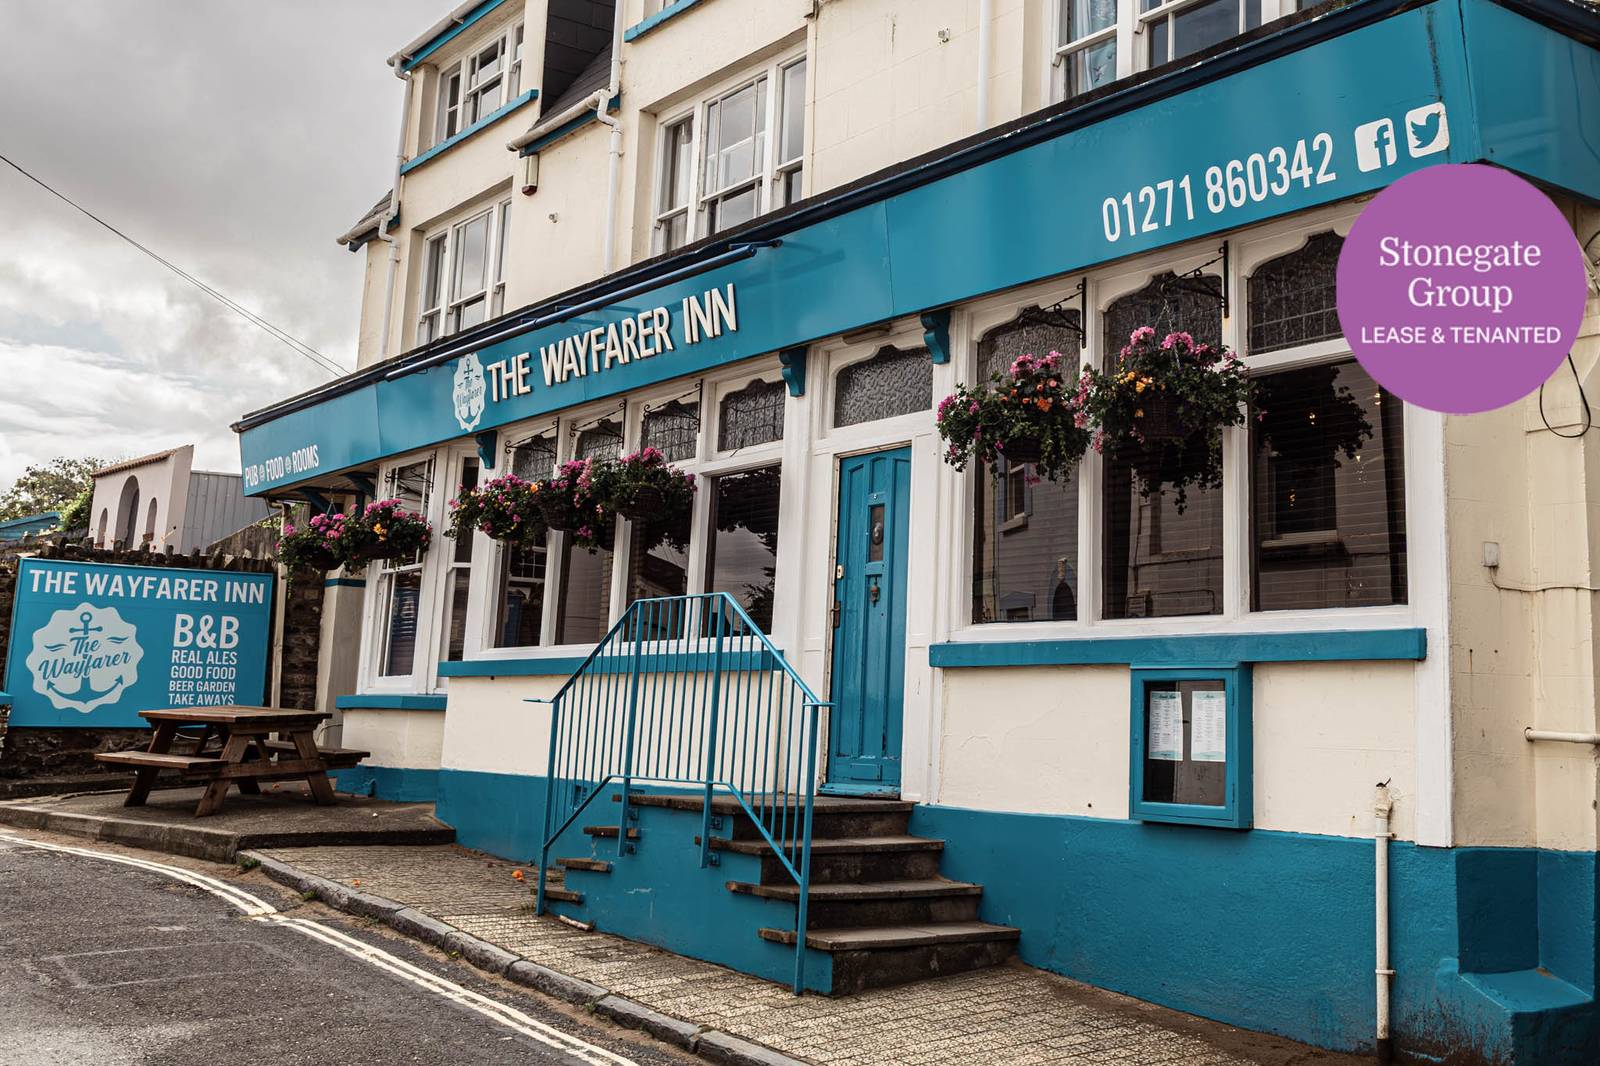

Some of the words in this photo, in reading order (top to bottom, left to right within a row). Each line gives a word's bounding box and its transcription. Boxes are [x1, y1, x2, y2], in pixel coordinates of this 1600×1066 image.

[1102, 174, 1194, 242] 01271
[1205, 132, 1337, 214] 860342
[487, 351, 532, 402] THE
[540, 306, 674, 387] WAYFARER
[682, 283, 738, 345] INN
[245, 464, 259, 488] PUB
[265, 456, 284, 481] FOOD
[292, 444, 319, 474] ROOMS
[29, 569, 78, 595] THE
[85, 573, 218, 602] WAYFARER
[225, 581, 265, 604] INN
[70, 634, 101, 657] The
[173, 613, 240, 648] B&B
[38, 650, 131, 680] Wayfarer
[170, 665, 203, 679] GOOD
[205, 666, 236, 679] FOOD
[171, 649, 203, 664] REAL
[206, 650, 238, 665] ALES
[168, 693, 195, 705] TAKE
[196, 694, 235, 706] AWAYS
[169, 680, 194, 692] BEER
[196, 681, 235, 692] GARDEN
